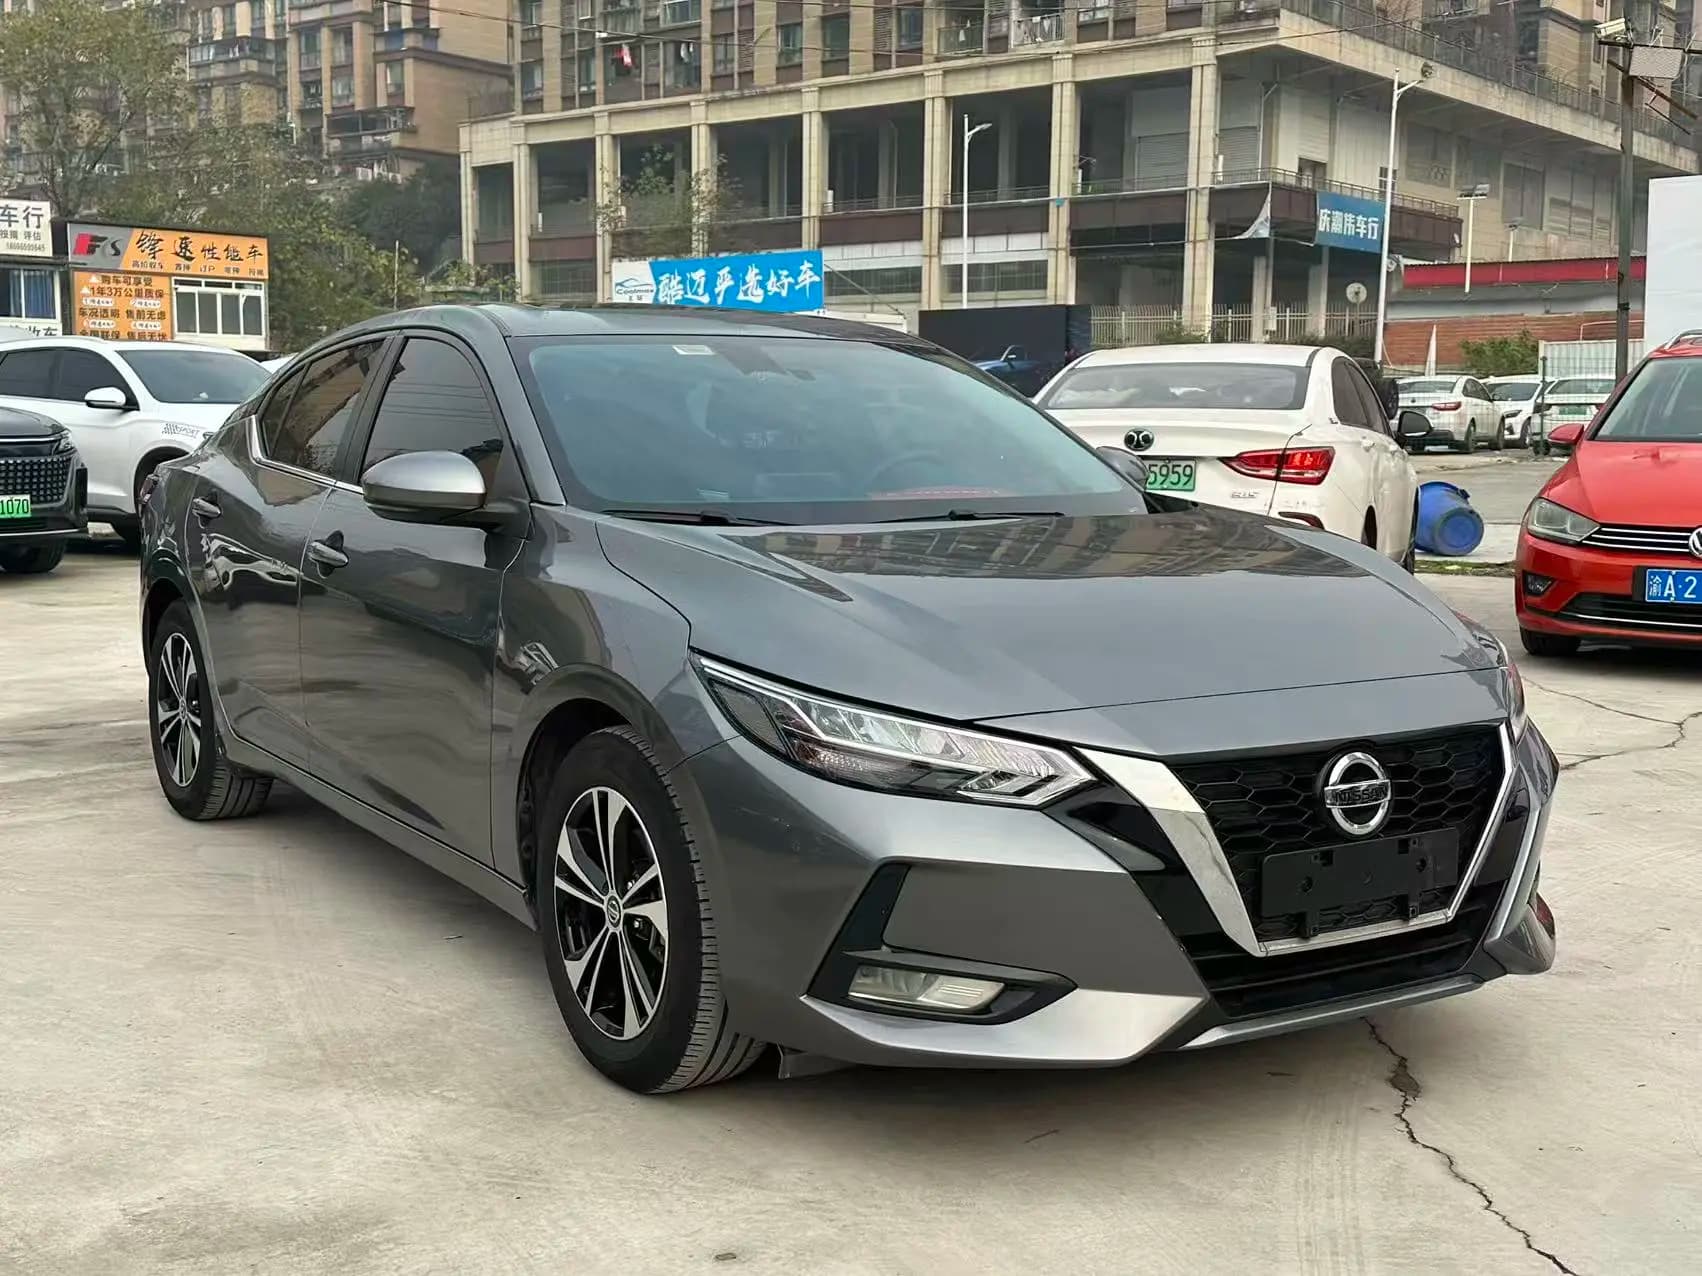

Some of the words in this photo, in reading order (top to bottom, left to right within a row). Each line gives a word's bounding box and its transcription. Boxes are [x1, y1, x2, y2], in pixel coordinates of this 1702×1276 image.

[0, 204, 44, 229] 车行
[101, 274, 153, 287] 购车可享受
[658, 259, 821, 305] 酷迈严选好车
[90, 286, 165, 299] 1年3万公里质保
[79, 307, 120, 319] 车况透明
[126, 309, 167, 321] 售前无虑
[1147, 463, 1194, 487] 5959
[0, 498, 29, 515] 1070
[1334, 784, 1388, 804] NISSAN
